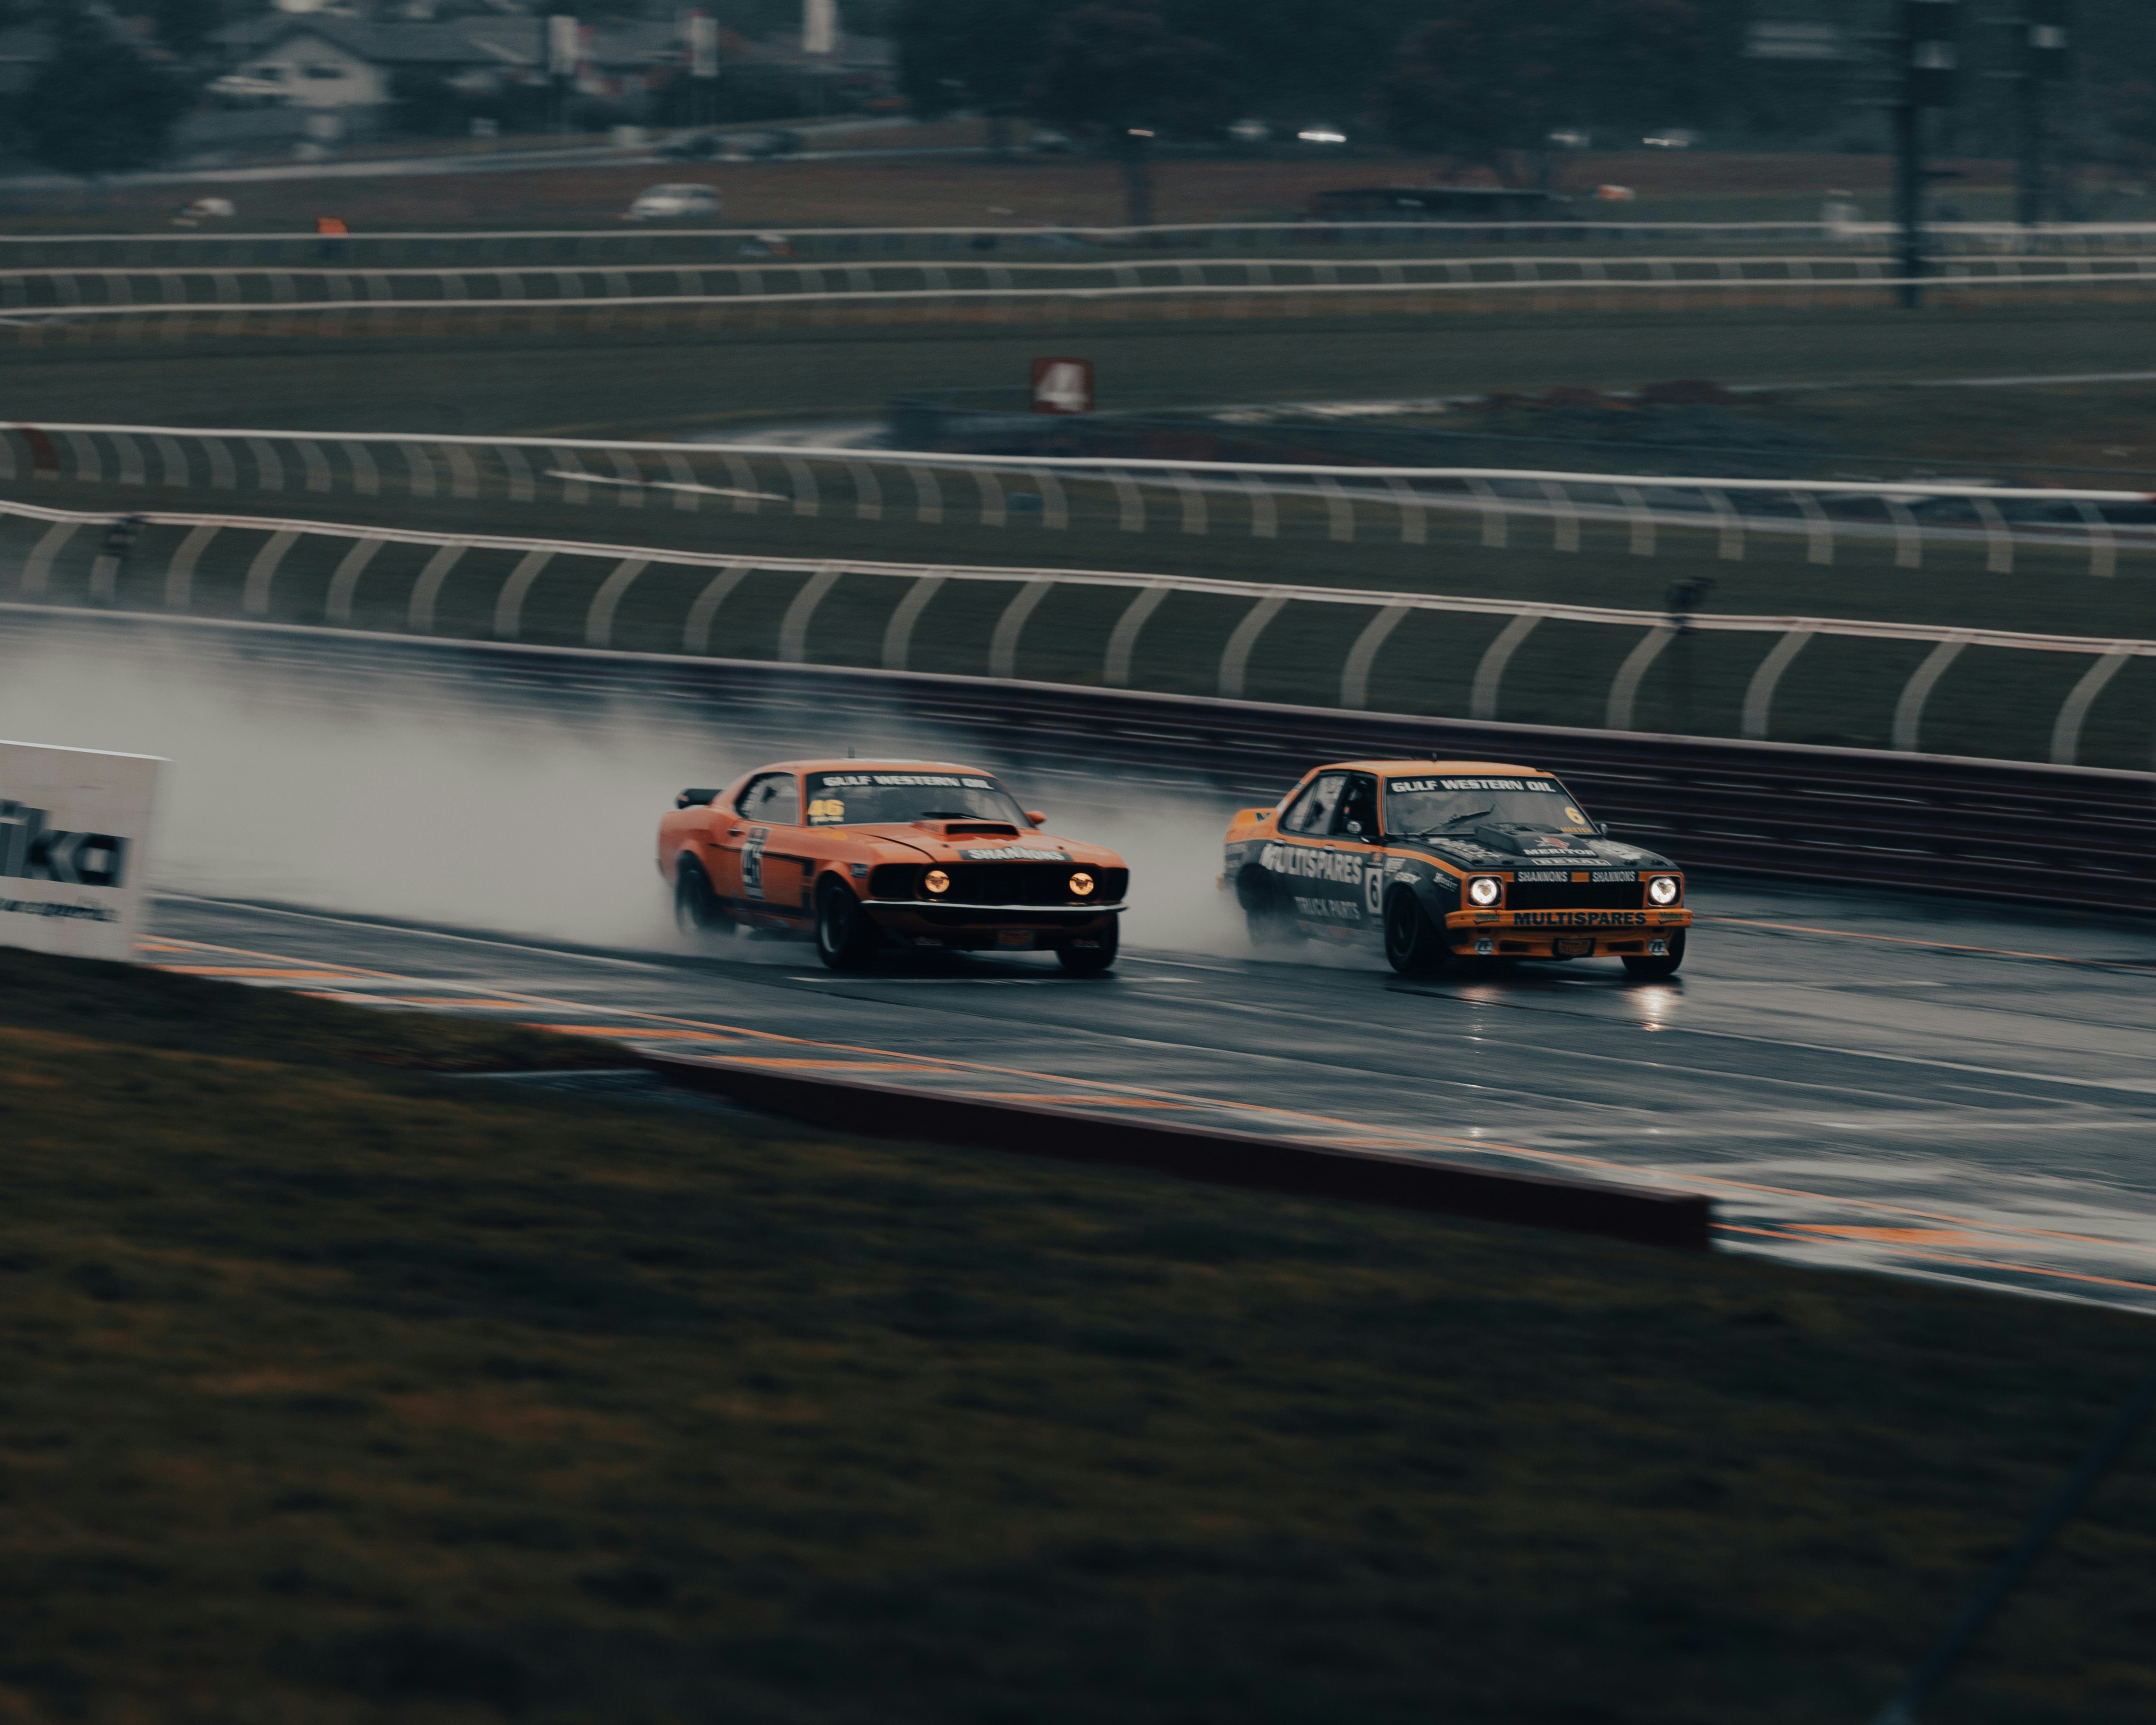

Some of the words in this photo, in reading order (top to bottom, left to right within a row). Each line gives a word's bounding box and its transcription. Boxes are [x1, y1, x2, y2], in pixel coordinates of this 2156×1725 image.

[1034, 363, 1089, 411] 4
[822, 776, 872, 787] GULF
[872, 775, 961, 787] WESTERN
[961, 778, 995, 790] OIL
[1391, 780, 1438, 793] GULF
[1440, 779, 1525, 791] WESTERN
[1525, 781, 1557, 793] OIL
[807, 799, 845, 816] 46
[1564, 806, 1585, 825] 6
[967, 846, 1066, 861] SHANNONS
[1523, 849, 1597, 857] MERITOR
[1259, 843, 1363, 885] MULTISPARES
[1517, 871, 1568, 882] SHANNONS
[1592, 871, 1636, 882] SHANNONS
[1370, 874, 1380, 908] 6
[1514, 912, 1647, 925] MULTISPARES
